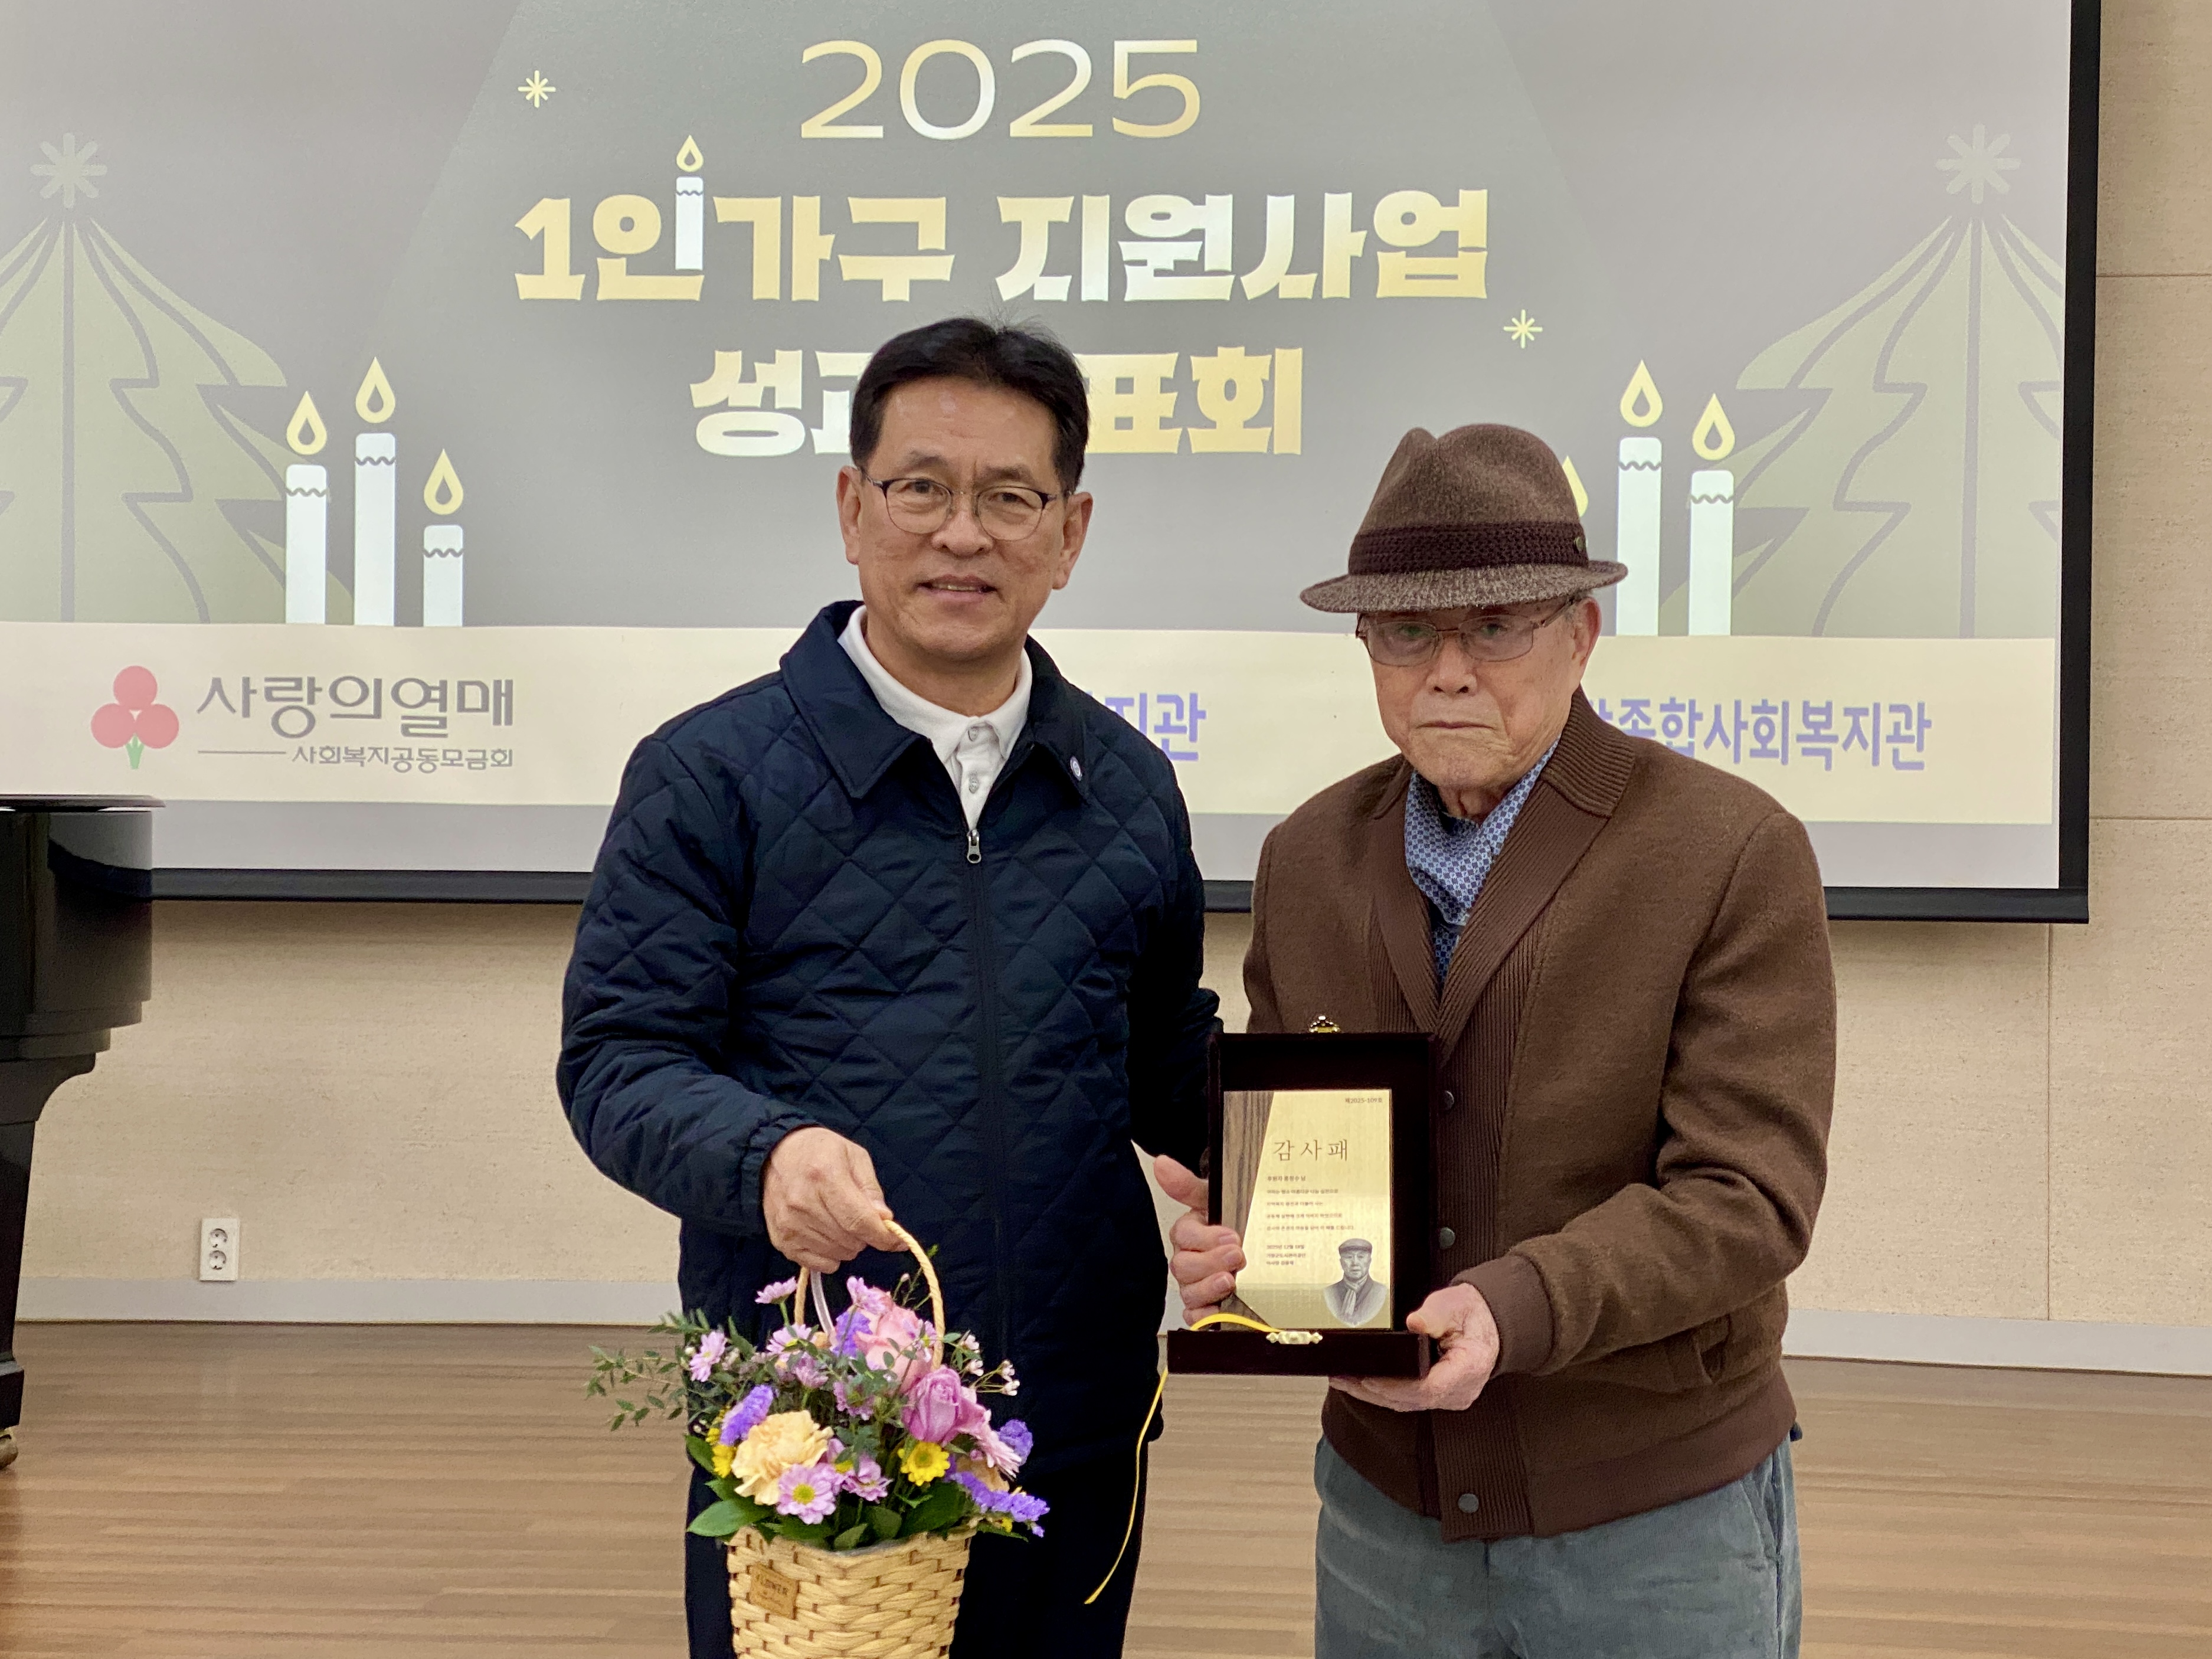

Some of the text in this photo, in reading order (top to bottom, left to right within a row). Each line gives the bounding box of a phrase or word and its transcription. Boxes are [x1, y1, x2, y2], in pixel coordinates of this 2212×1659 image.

[799, 38, 1202, 140] 2025
[514, 177, 1489, 303] 1인가구 지원사업
[197, 675, 514, 739] 사랑의열매
[1086, 691, 1207, 761] 지관
[291, 745, 513, 774] 사회복지공동모금회
